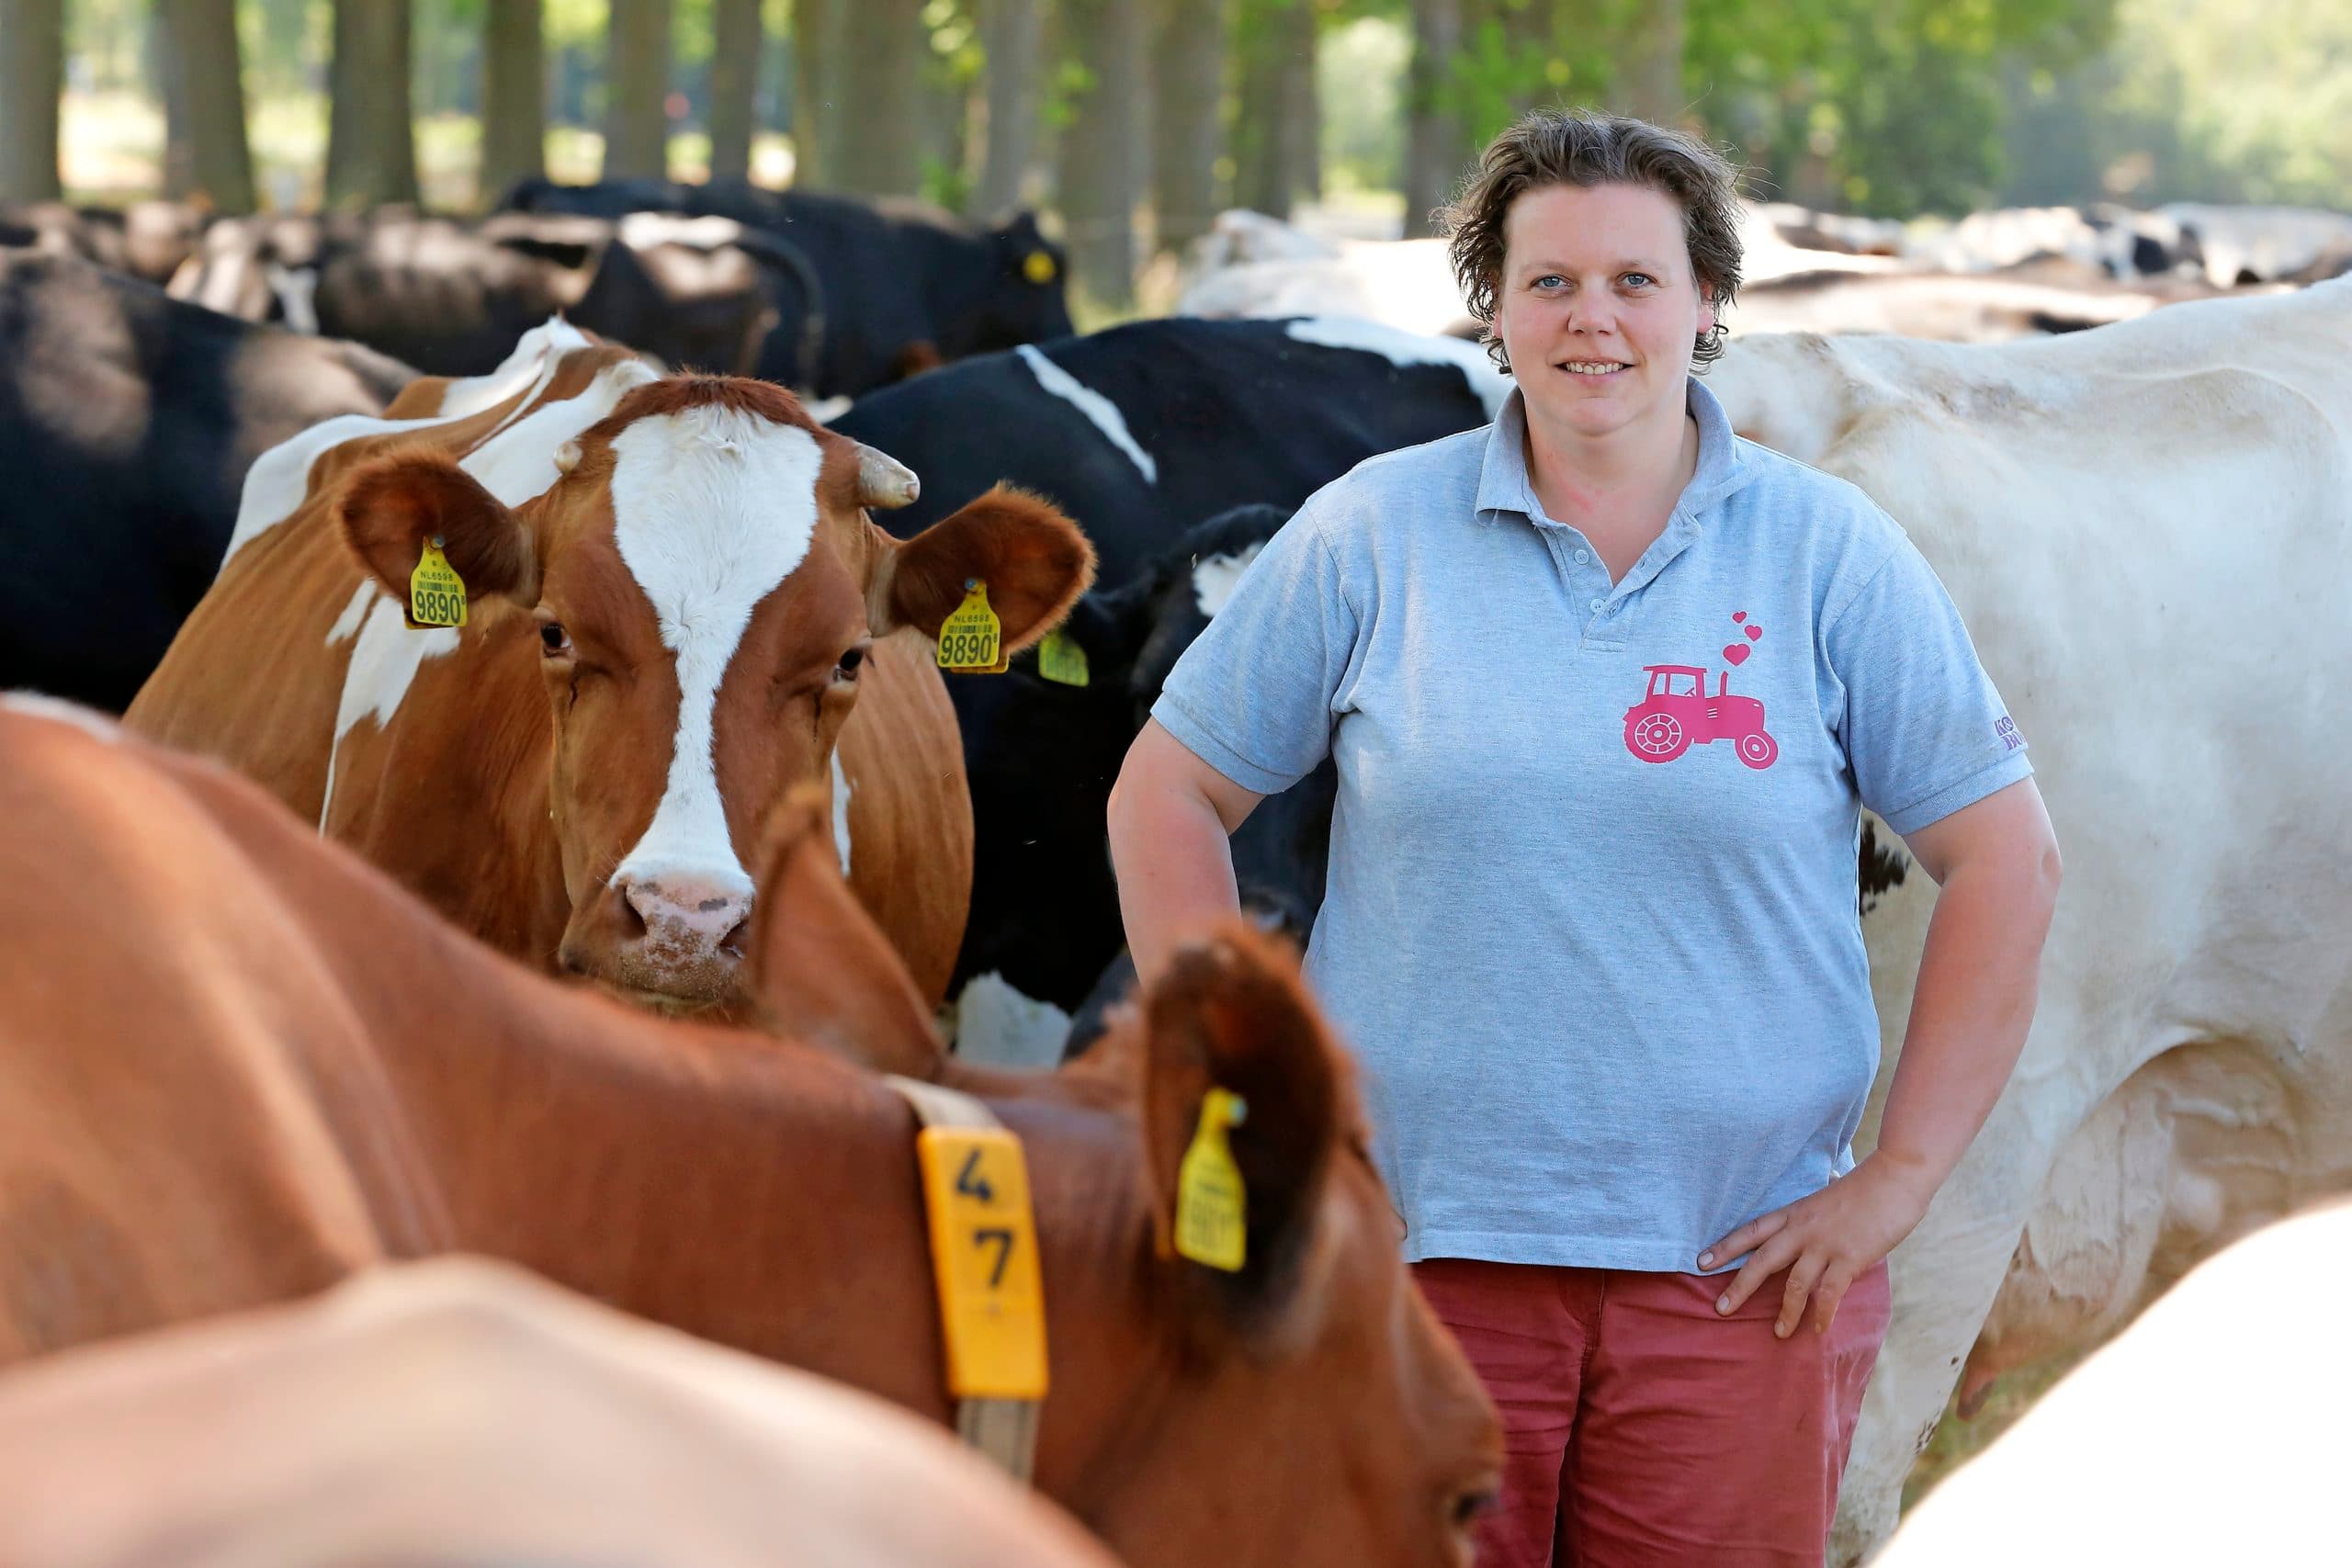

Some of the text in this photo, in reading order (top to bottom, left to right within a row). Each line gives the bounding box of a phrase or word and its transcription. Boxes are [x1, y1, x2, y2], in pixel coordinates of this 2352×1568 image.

[415, 590, 461, 624] 9890
[940, 634, 992, 664] 9890
[1995, 716, 2014, 737] KO
